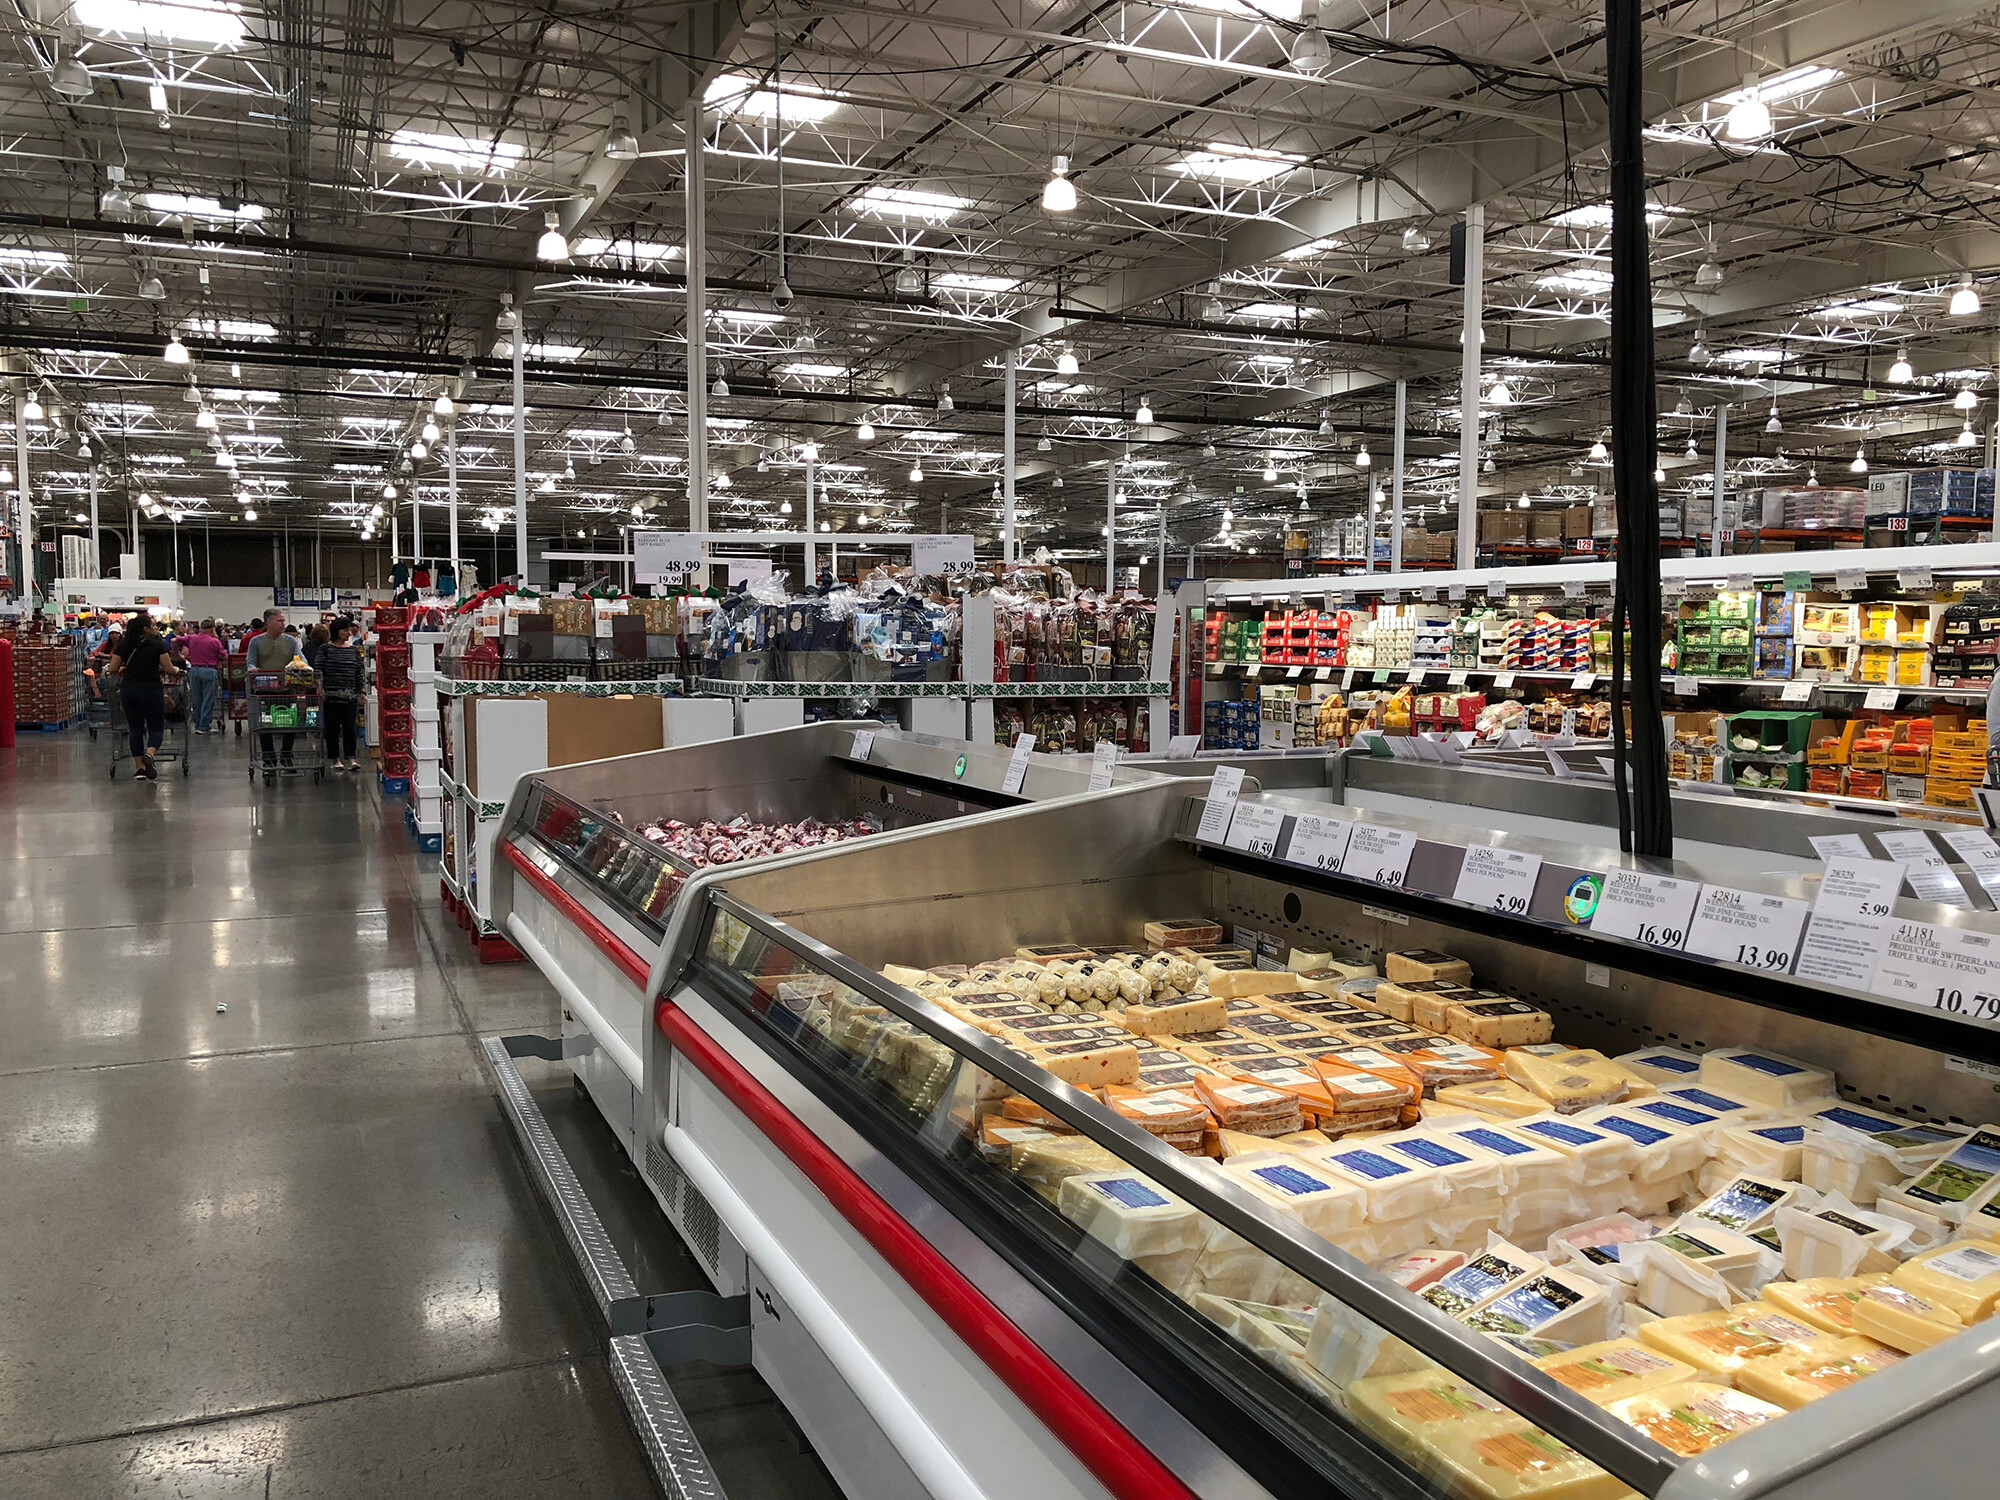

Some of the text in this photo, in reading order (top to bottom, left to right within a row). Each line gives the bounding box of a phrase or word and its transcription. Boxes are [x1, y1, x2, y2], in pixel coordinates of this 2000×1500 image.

[1870, 482, 1885, 492] LED
[1889, 518, 1906, 530] 133
[1718, 530, 1733, 541] 131
[42, 543, 55, 551] 319
[1578, 540, 1592, 550] 129
[666, 560, 700, 572] 48.99
[942, 561, 974, 572] 28.99
[1290, 560, 1301, 568] 123
[658, 576, 682, 584] 19.99
[1248, 839, 1273, 856] 10.59
[1474, 848, 1494, 859] 14256
[1317, 854, 1340, 871] 9.99
[1477, 863, 1494, 871] PEPPER
[1925, 858, 1944, 867] 9.59
[1376, 867, 1402, 886] 6.49
[1488, 871, 1504, 879] POUND
[1616, 872, 1641, 886] 30331
[1623, 882, 1652, 893] LEICESTER
[1606, 894, 1622, 902] PRICE
[1635, 899, 1655, 908] POUND
[1634, 892, 1655, 901] CHEESE
[1711, 890, 1741, 904] 42814
[1494, 894, 1526, 914] 5.99
[1706, 898, 1745, 911] WESTCOMBE
[1859, 902, 1889, 917] 5.99
[1701, 912, 1757, 928] PRICE PER POUND
[1704, 905, 1716, 913] THE
[1717, 908, 1732, 916] FINE
[1733, 912, 1758, 922] CHEESE
[1635, 923, 1682, 947] 16.99
[1898, 924, 1934, 940] 41181
[1891, 934, 1941, 949] LE GRUYERE
[1736, 944, 1788, 972] 13.99
[1889, 941, 1926, 954] PRODUCT
[1928, 948, 1940, 956] OF
[1941, 951, 2000, 969] SWTIZERLAND
[1888, 949, 1914, 960] TRIPLE
[1916, 954, 1948, 967] SOURCE
[1956, 962, 1986, 975] POUND
[1893, 978, 1918, 989] 10.790
[1932, 987, 2000, 1020] 10.79
[1966, 1060, 1986, 1072] SAFE
